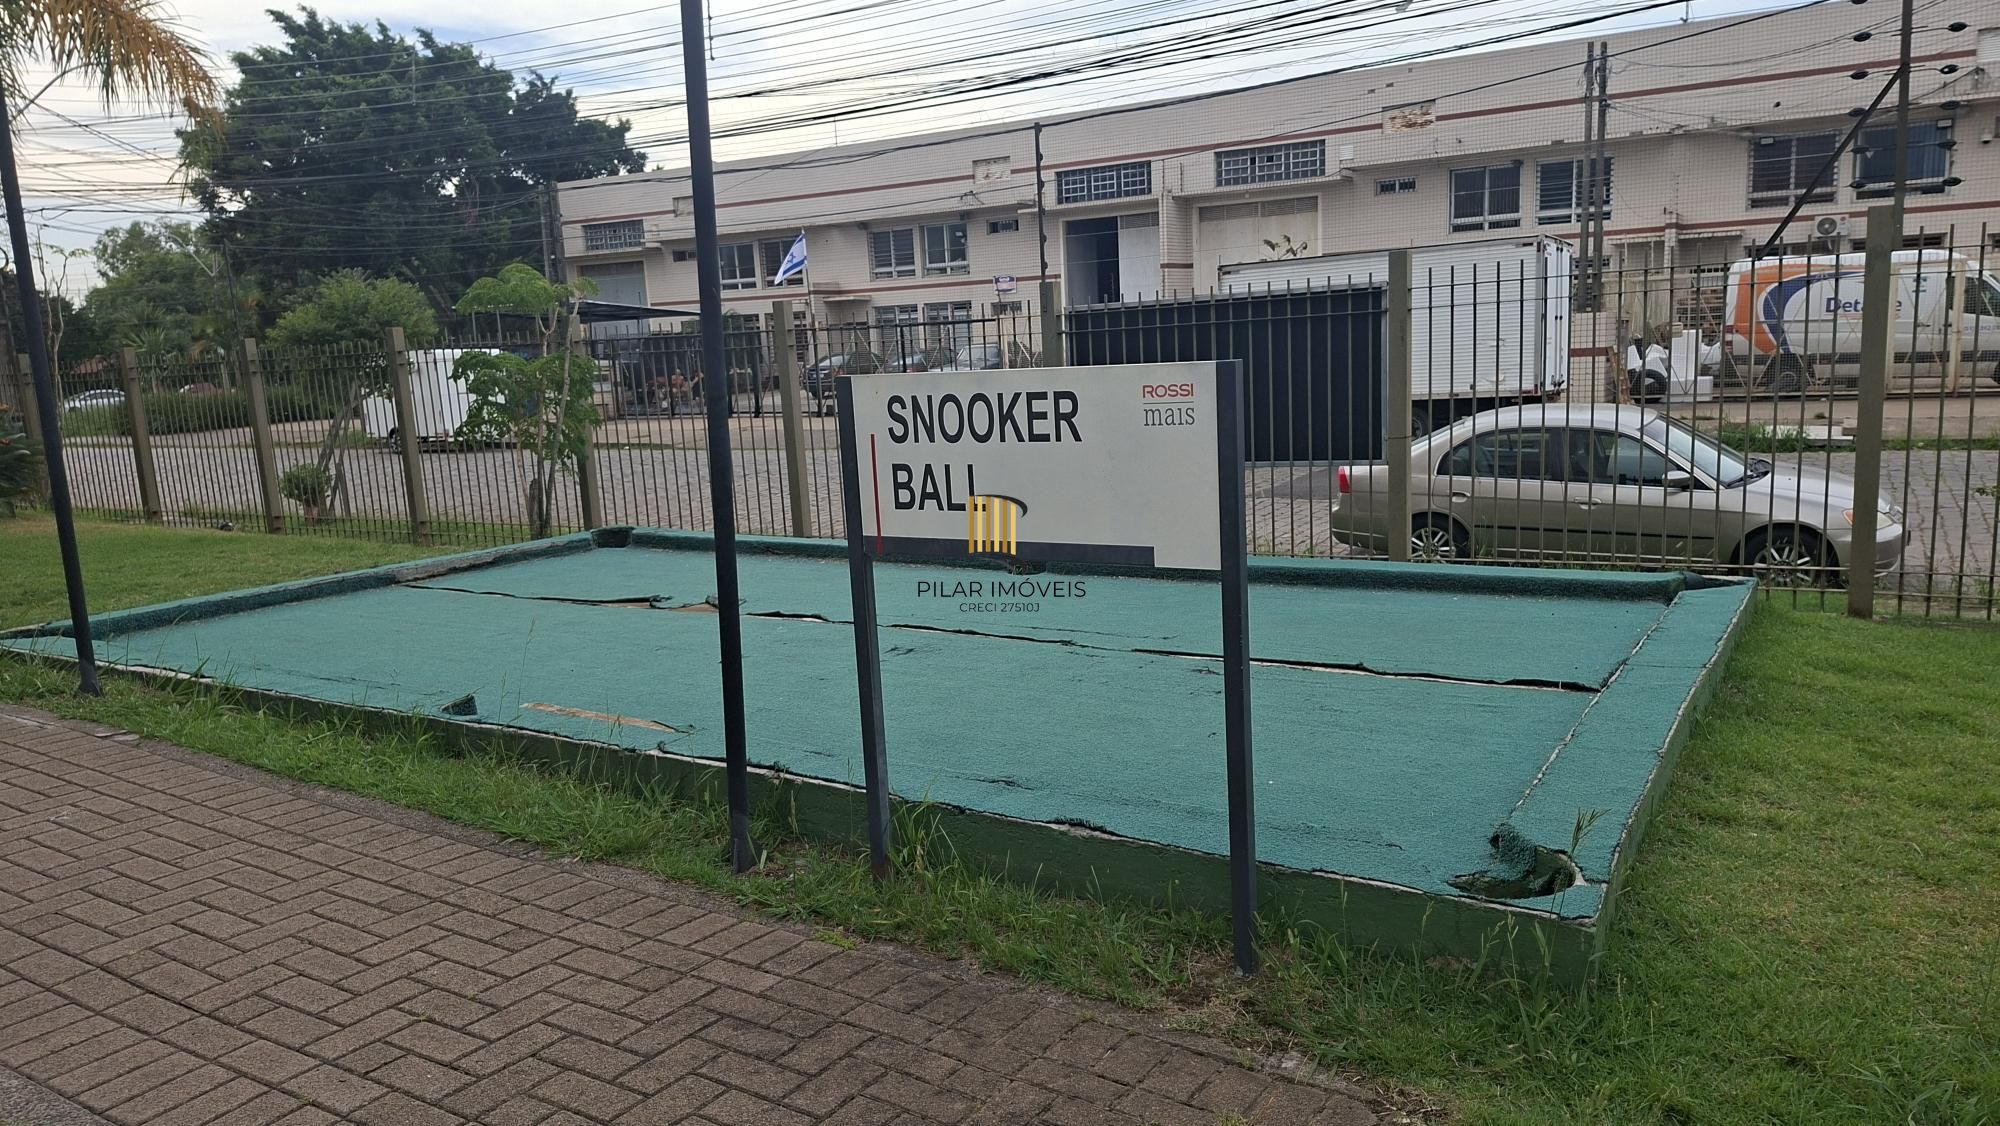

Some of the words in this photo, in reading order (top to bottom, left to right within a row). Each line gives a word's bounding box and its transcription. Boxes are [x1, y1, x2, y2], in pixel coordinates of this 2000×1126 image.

[1142, 383, 1194, 399] ROSSI
[887, 390, 1082, 444] SNOOKER
[1143, 407, 1195, 427] mais
[891, 463, 987, 512] BALL
